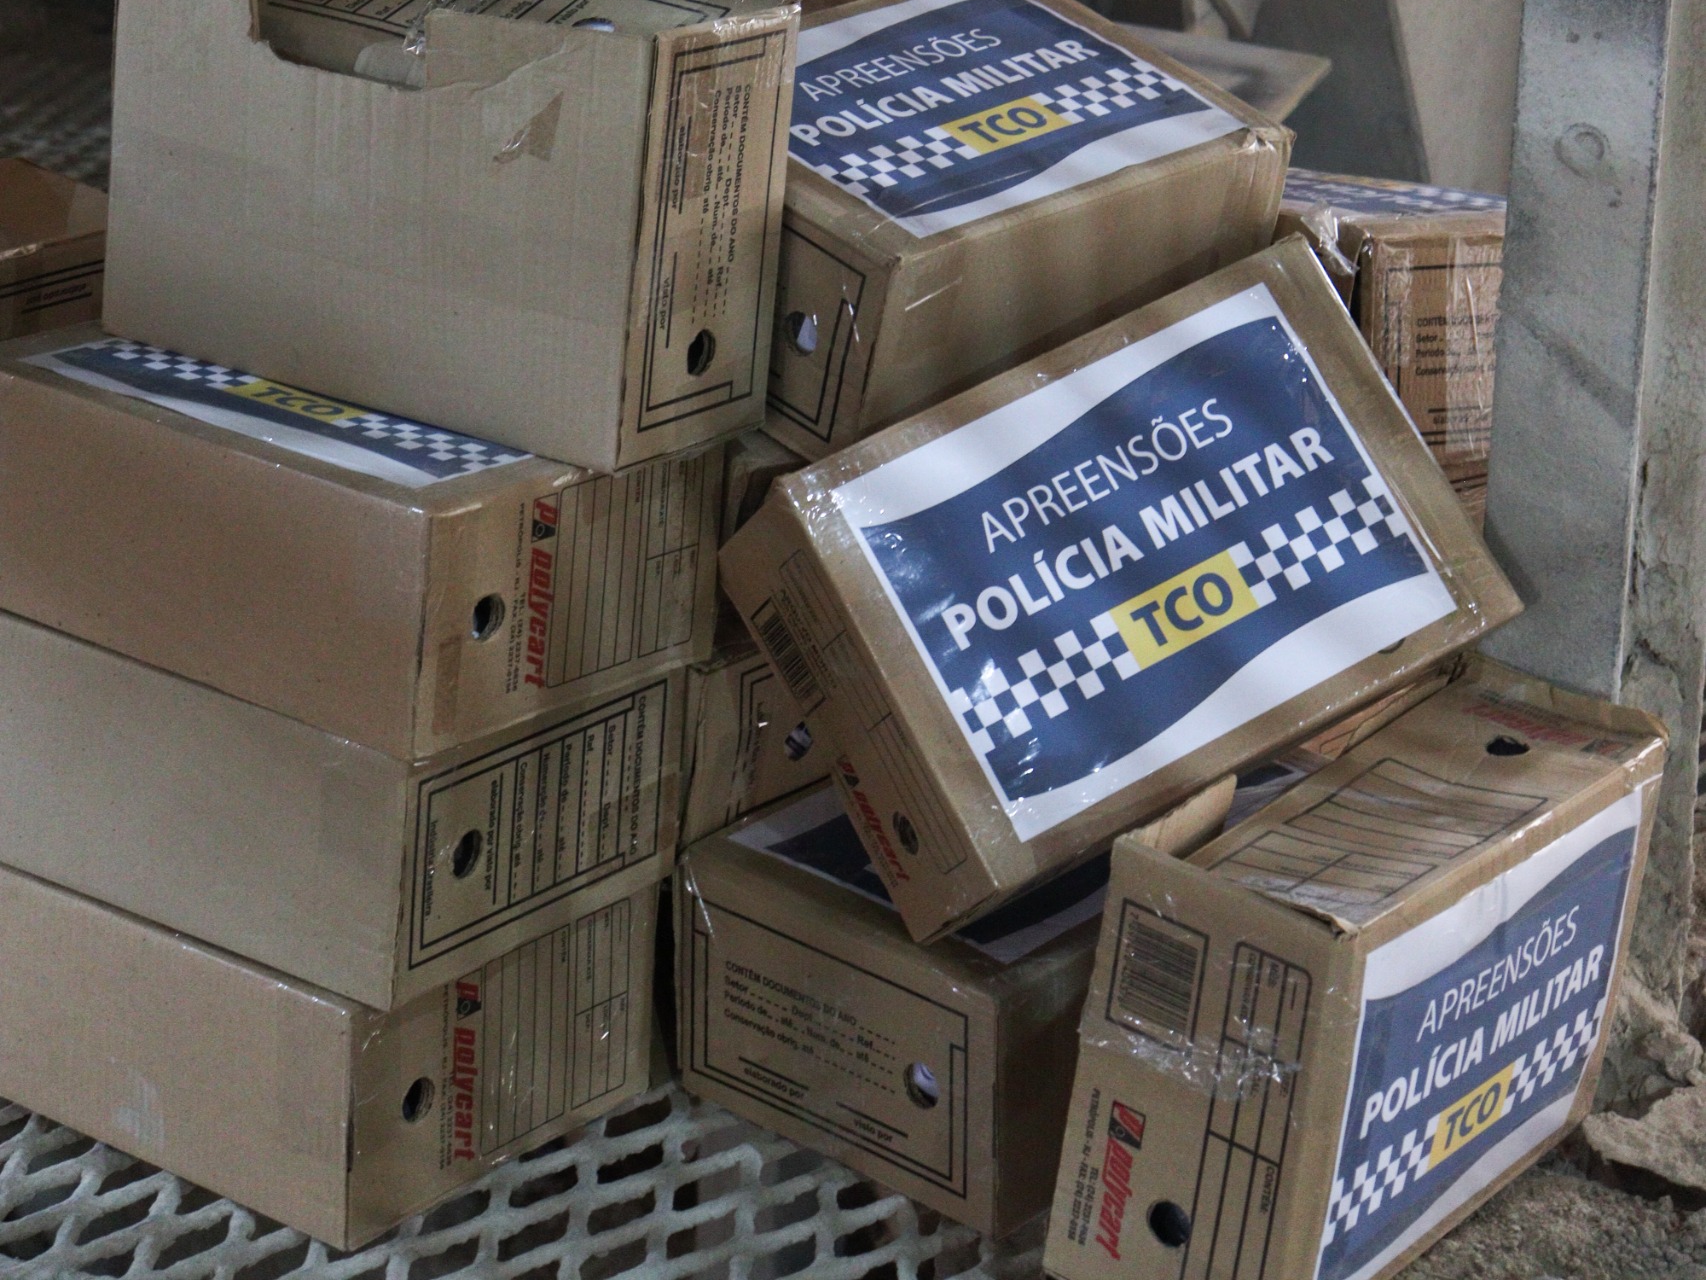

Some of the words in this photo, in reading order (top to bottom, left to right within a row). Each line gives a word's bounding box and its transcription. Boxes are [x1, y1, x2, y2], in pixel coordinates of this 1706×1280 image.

[731, 85, 741, 118] Setor
[790, 85, 954, 147] POLÍCIA
[955, 37, 1100, 106] MILITAR
[798, 28, 1002, 103] APREENSÕES
[706, 89, 721, 160] Conservação
[960, 104, 1046, 144] TCO
[731, 135, 745, 215] DOCUMENTOS
[727, 238, 735, 261] ANO
[250, 386, 346, 417] TCO
[981, 399, 1233, 553] APREENSÕES
[941, 525, 1144, 651] POLÍCIA
[1139, 426, 1335, 549] MILITAR
[525, 547, 554, 688] polycart
[1130, 572, 1233, 647] TCO
[606, 723, 616, 756] Setor
[631, 740, 643, 813] DOCUMENTOS
[486, 828, 495, 846] por
[488, 778, 498, 828] elaborado
[484, 872, 492, 892] por
[1416, 905, 1579, 1042] APREENSÕES
[1360, 1026, 1484, 1139] POLÍCIA
[1490, 945, 1604, 1055] MILITAR
[454, 1026, 478, 1161] polycart
[1444, 1082, 1502, 1151] TCO
[1096, 1138, 1133, 1260] polycart
